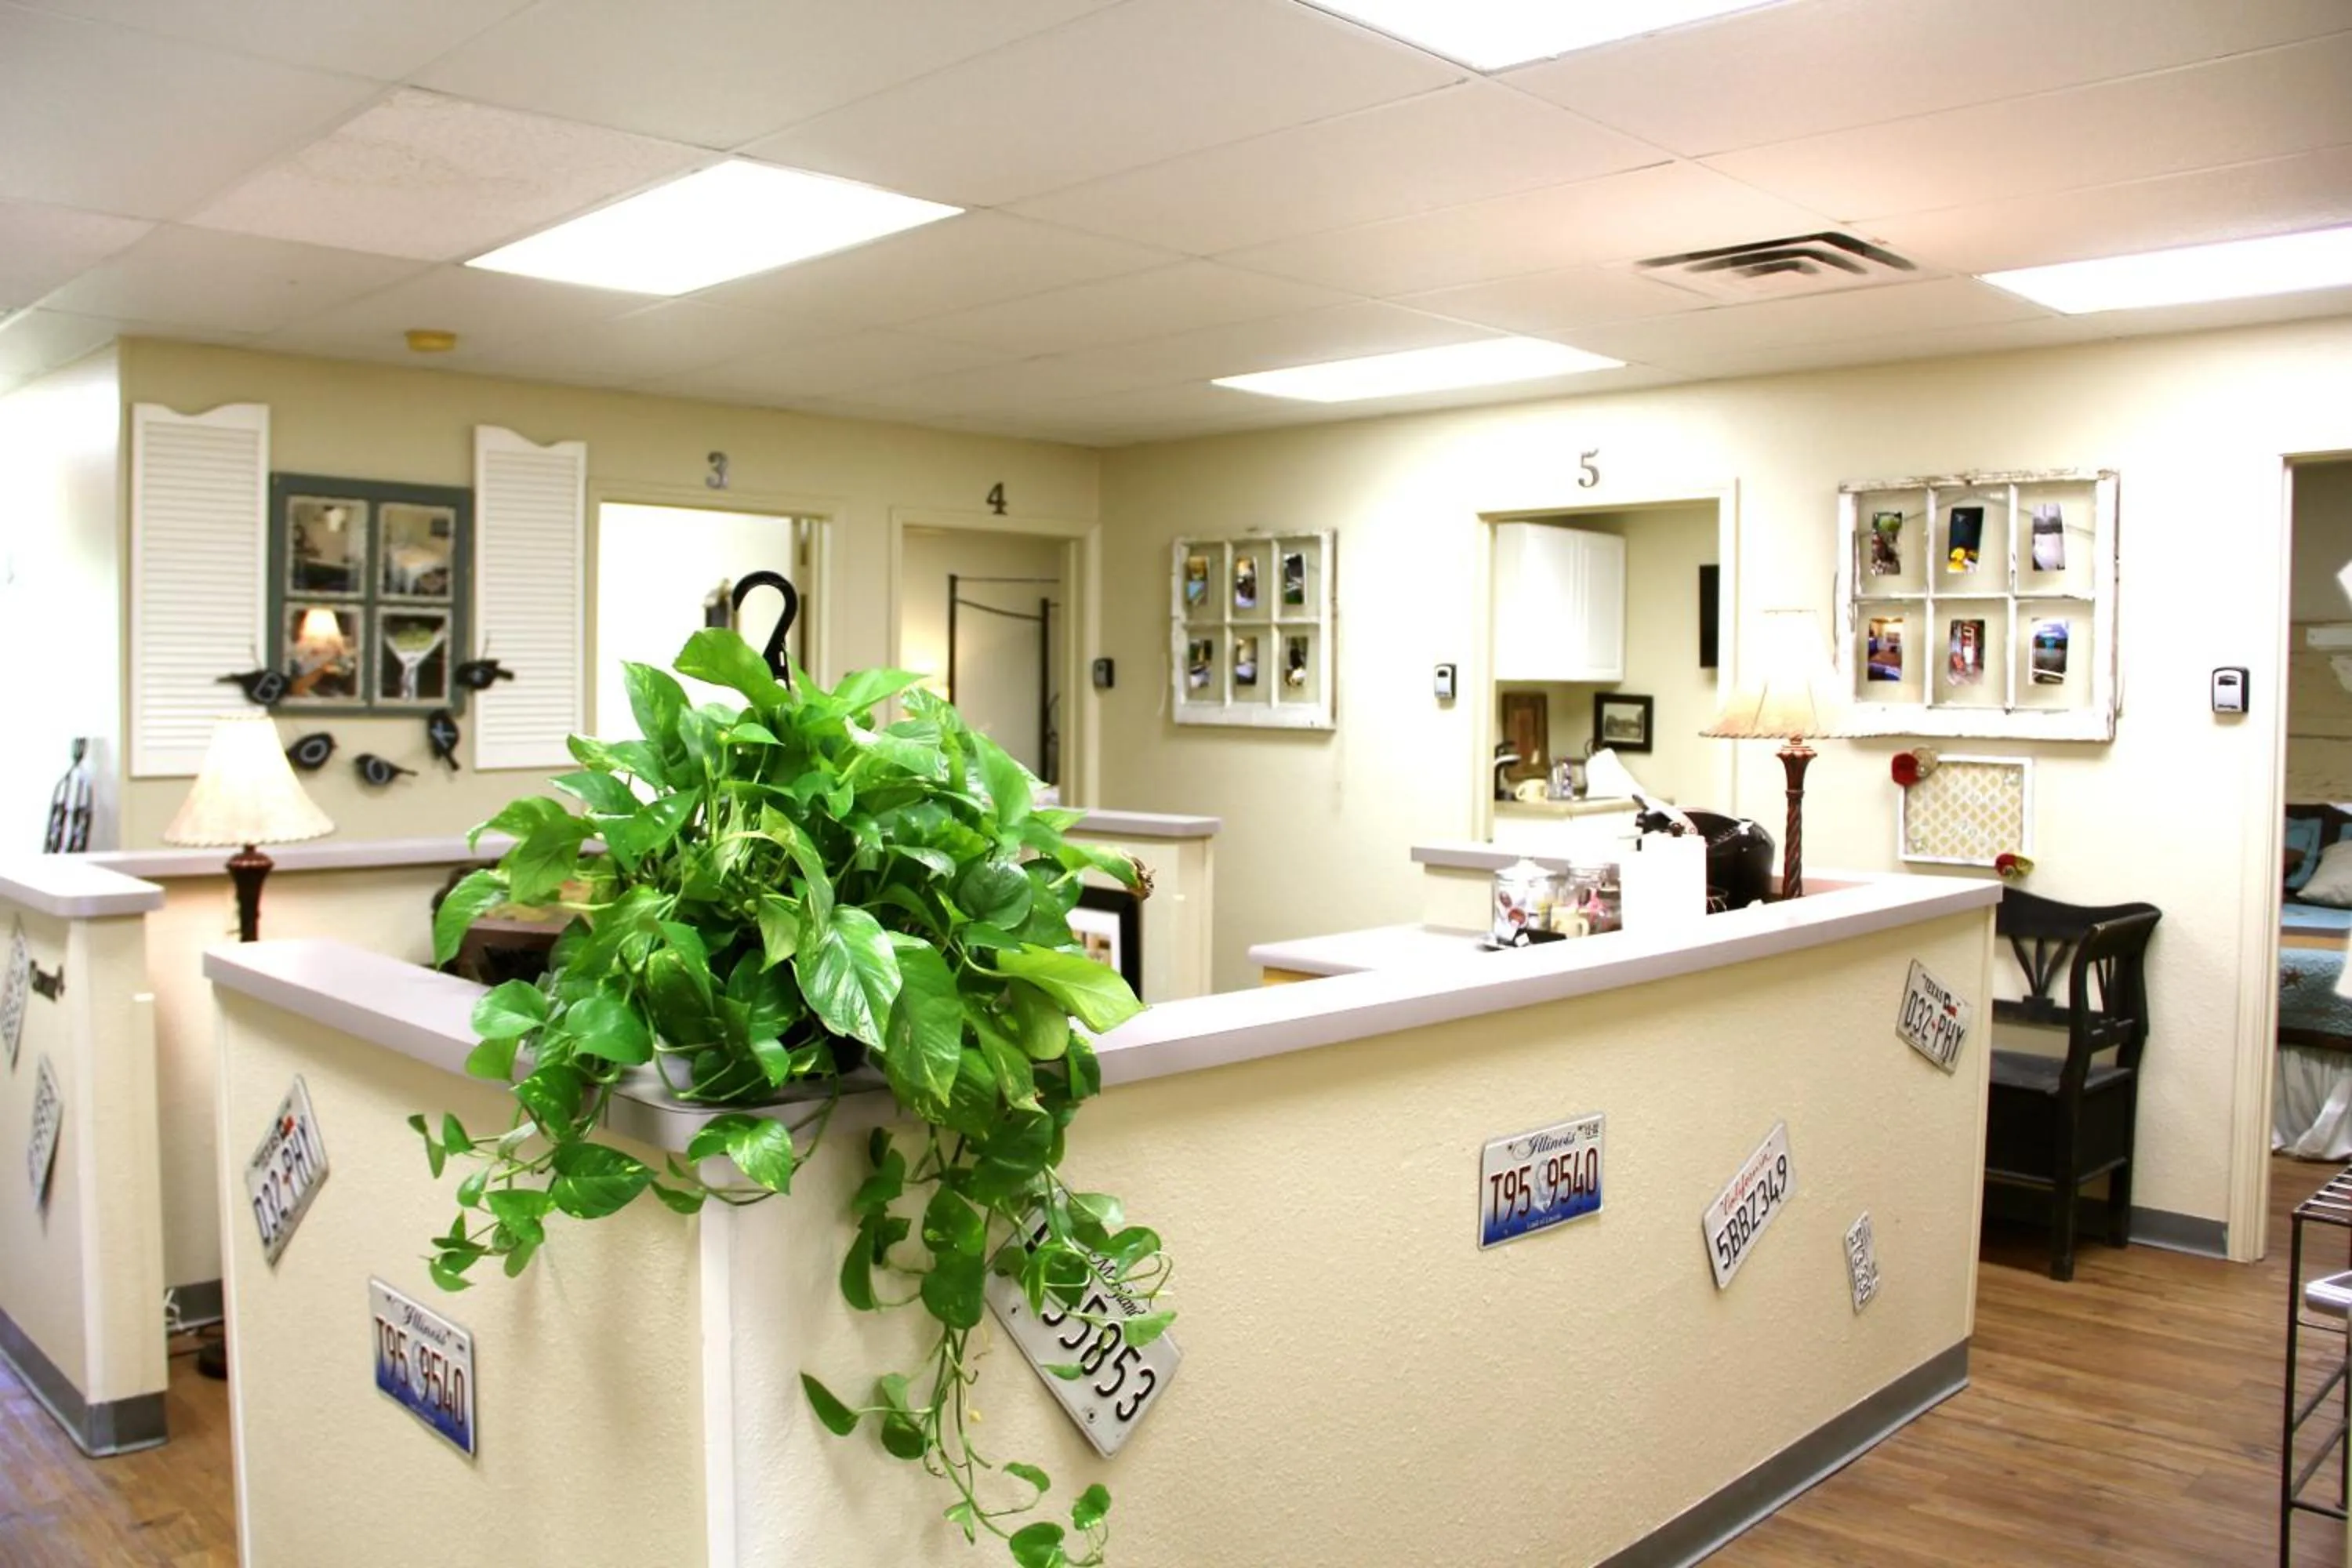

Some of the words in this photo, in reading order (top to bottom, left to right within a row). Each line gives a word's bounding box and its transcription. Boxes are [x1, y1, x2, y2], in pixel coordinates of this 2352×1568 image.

[707, 452, 728, 489] 3
[1578, 448, 1599, 488] 5
[986, 481, 1007, 515] 4
[1517, 1132, 1576, 1160] Illinois
[1490, 1164, 1531, 1225] T95
[1547, 1148, 1597, 1209] 9540
[376, 1316, 409, 1388] T95
[420, 1343, 465, 1425] 9540
